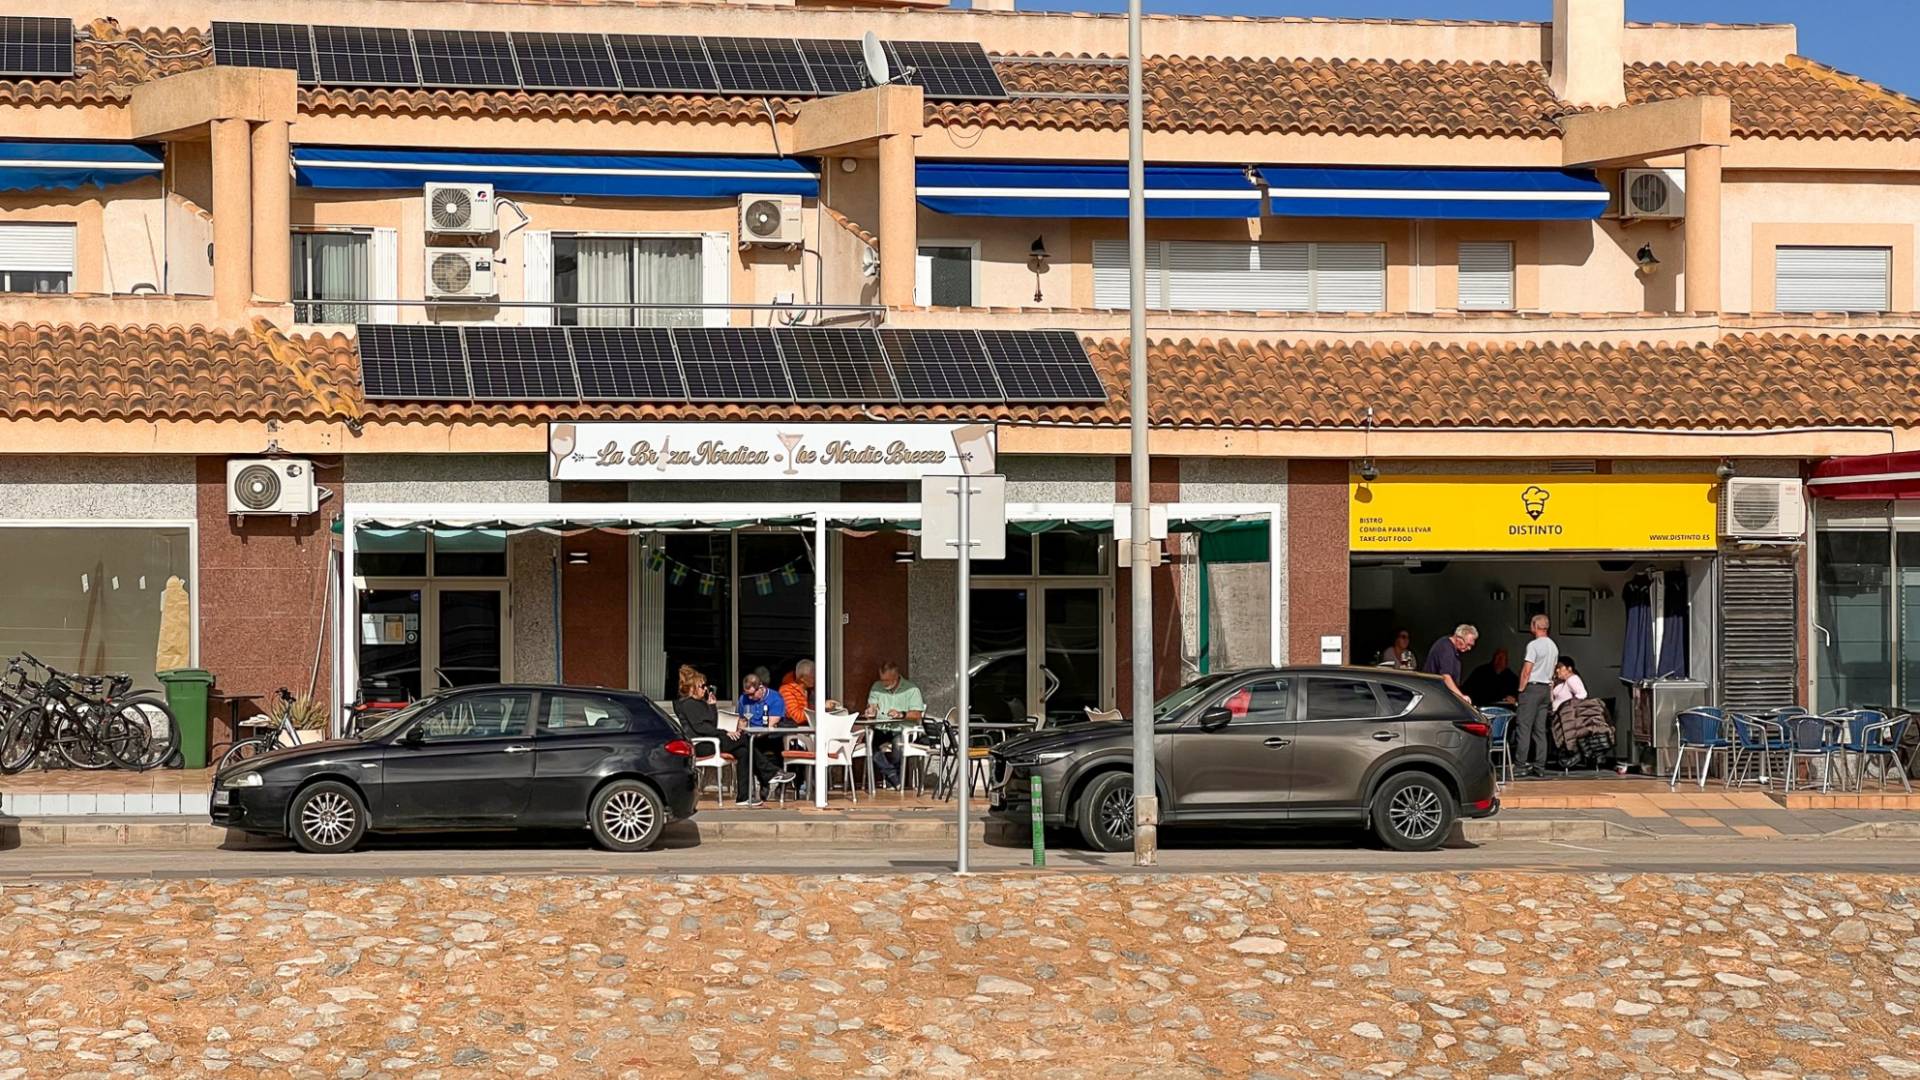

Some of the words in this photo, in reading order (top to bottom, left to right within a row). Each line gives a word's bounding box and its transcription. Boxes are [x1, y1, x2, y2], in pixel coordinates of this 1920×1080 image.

[596, 440, 625, 467] La
[628, 435, 692, 472] Brza
[819, 440, 885, 466] Nordic
[884, 440, 947, 466] Breeze
[1508, 525, 1563, 536] DISTINTO
